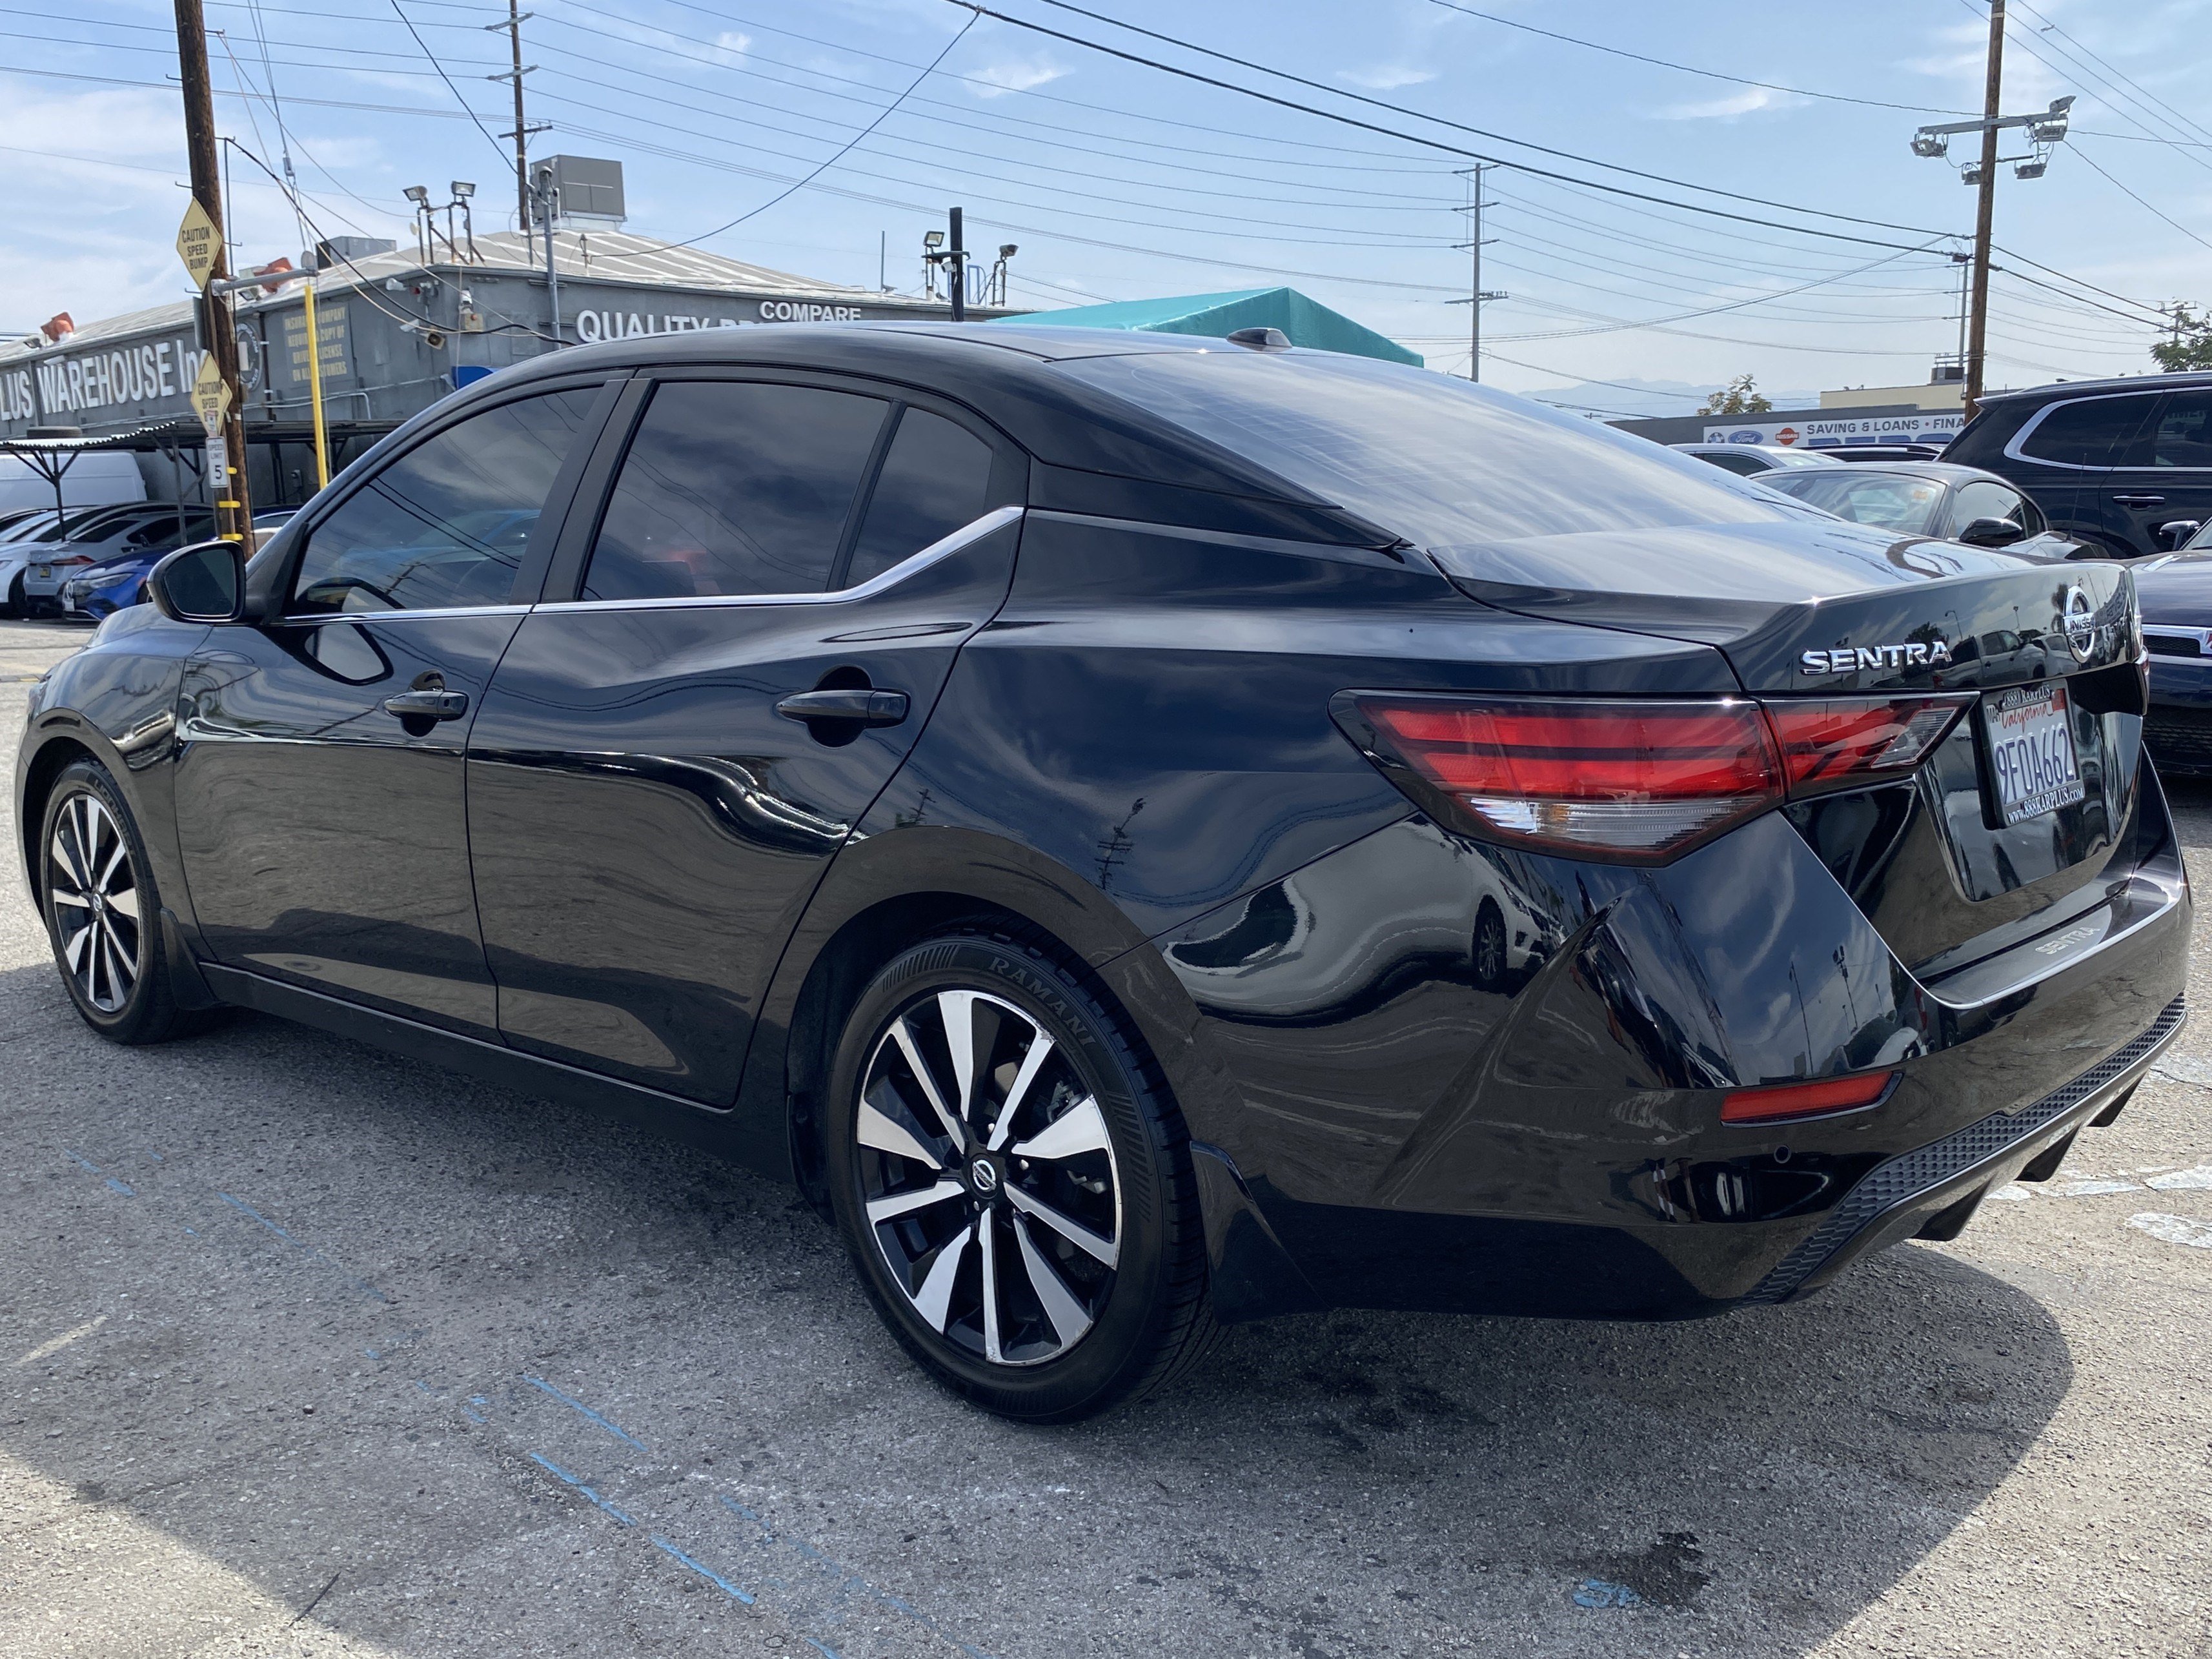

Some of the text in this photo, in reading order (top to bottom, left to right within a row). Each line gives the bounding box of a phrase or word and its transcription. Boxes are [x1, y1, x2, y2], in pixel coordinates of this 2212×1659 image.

[182, 227, 210, 243] CAUTION
[187, 243, 208, 256] SPEED
[189, 257, 208, 270] BUMP
[759, 301, 862, 321] COMPARE
[37, 341, 176, 414] WAREHOUSE
[202, 397, 218, 409] SPEED
[1807, 423, 1856, 434] SAVING
[1874, 420, 1919, 431] LOANS
[214, 465, 222, 480] 5
[1801, 640, 1953, 675] SENTRA
[2035, 927, 2100, 955] SENTRA
[989, 957, 1096, 1047] RAMANI
